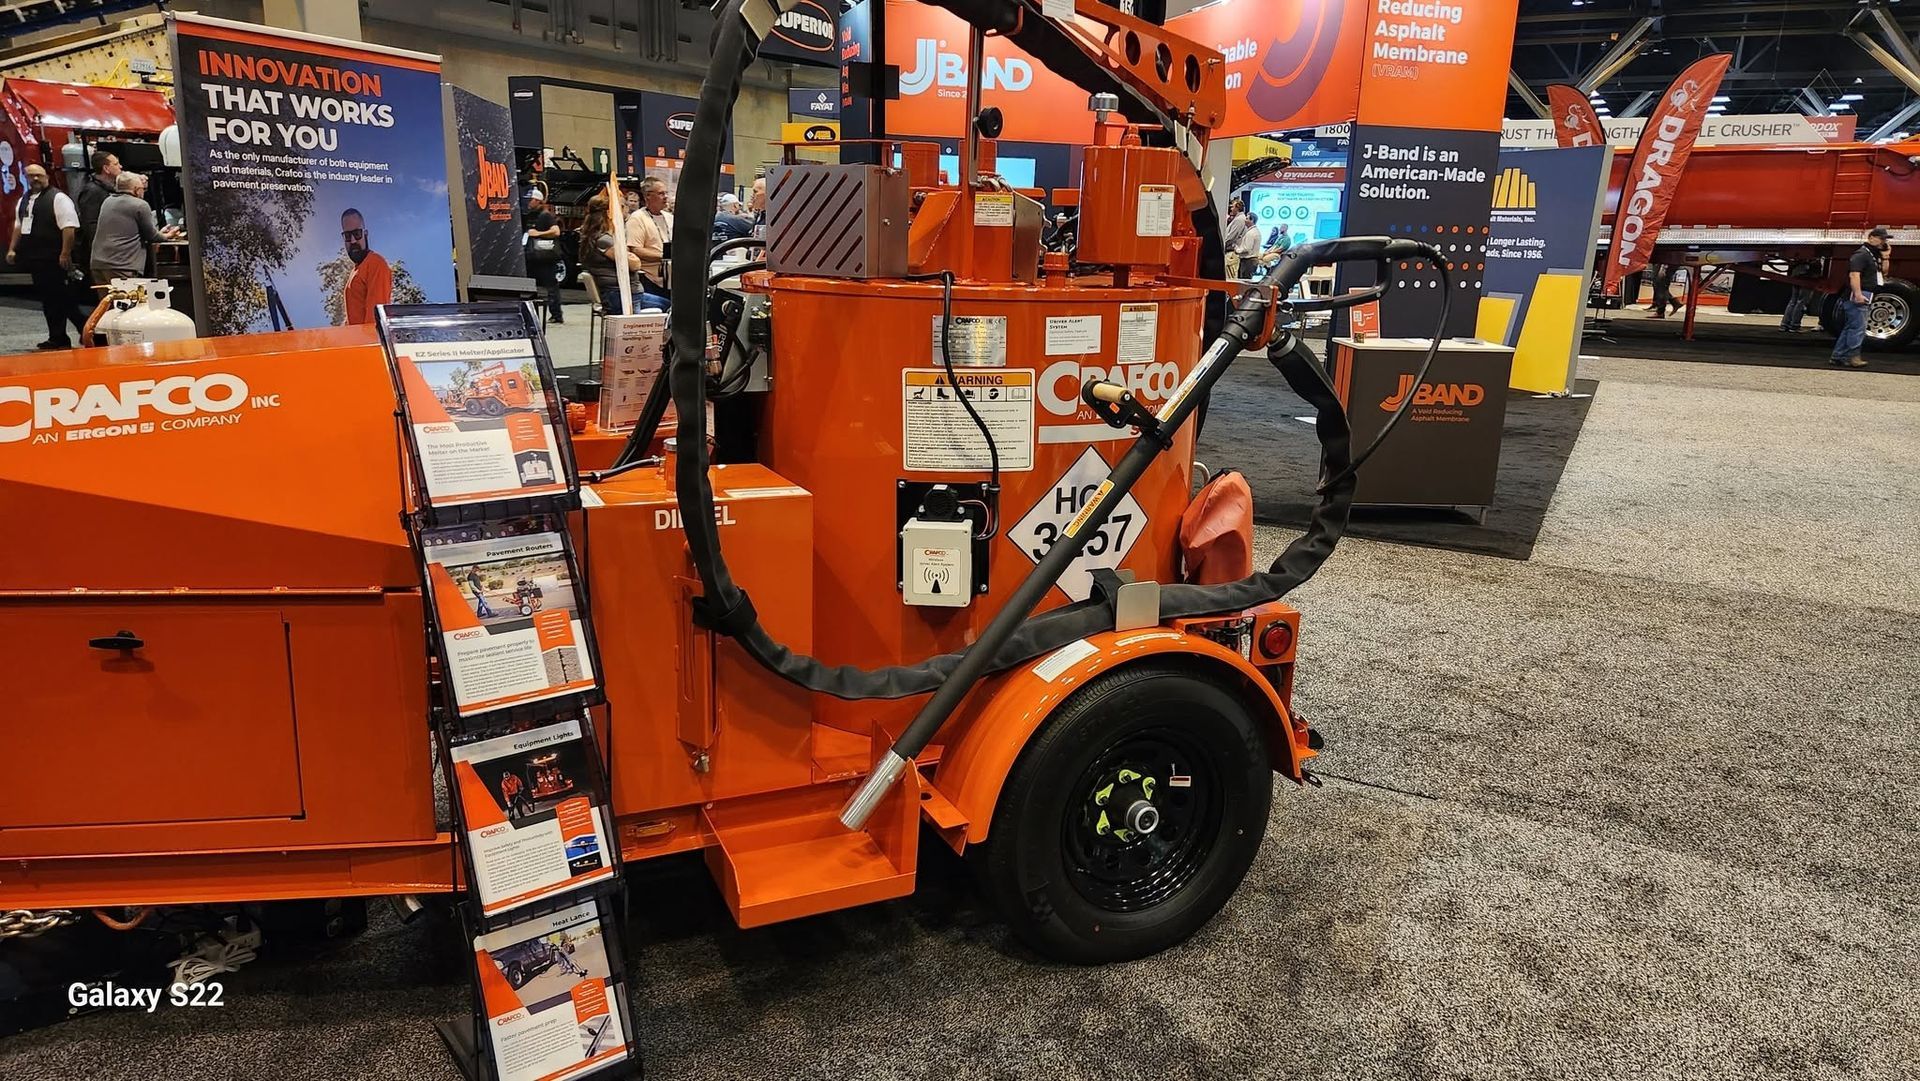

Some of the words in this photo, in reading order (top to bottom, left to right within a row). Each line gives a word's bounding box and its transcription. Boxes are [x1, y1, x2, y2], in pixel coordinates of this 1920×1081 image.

[1377, 0, 1463, 24] Reducing
[1375, 20, 1446, 42] Asphalt
[1218, 38, 1257, 65] nable
[1373, 42, 1469, 65] Membrane
[199, 50, 382, 97] INNOVATION
[1371, 63, 1420, 80] (VRAM)
[937, 89, 960, 98] Since
[201, 83, 284, 115] THAT
[288, 93, 394, 128] WORKS
[810, 102, 834, 111] FAYAT
[206, 116, 273, 146] FOR
[276, 123, 338, 151] YOU
[210, 149, 224, 159] As
[224, 150, 240, 160] the
[242, 152, 261, 163] only
[262, 154, 317, 166] manufacturer
[319, 157, 328, 167] of
[329, 158, 347, 168] both
[348, 160, 389, 172] equipment
[1362, 144, 1420, 162] J-Band
[1423, 146, 1436, 162] is
[1439, 149, 1459, 163] an
[211, 163, 230, 174] and
[231, 166, 274, 178] materials,
[275, 168, 303, 179] Crafco
[304, 170, 312, 179] is
[313, 170, 327, 180] the
[328, 171, 360, 184] industry
[360, 173, 384, 184] leader
[385, 175, 393, 184] in
[1283, 171, 1335, 179] DYNAPAC
[1361, 164, 1486, 183] American-Made
[213, 179, 259, 190] pavement
[260, 181, 314, 193] preservation.
[1359, 183, 1430, 200] Solution.
[1618, 114, 1686, 267] DRAGON
[1490, 237, 1515, 248] Longer
[1516, 237, 1546, 249] Lasting,
[1501, 249, 1522, 258] Since
[1523, 250, 1544, 259] 1956.
[459, 347, 524, 356] Melter/Applicator
[251, 394, 281, 409] INC
[1077, 409, 1093, 420] AN
[1433, 408, 1463, 416] Reducing
[32, 431, 59, 445] AN
[66, 424, 138, 442] ERGON
[160, 412, 243, 431] COMPANY
[655, 505, 736, 530] DIEL
[1073, 496, 1101, 527] WARNING
[1033, 514, 1132, 560] 357
[486, 547, 524, 558] Pavement
[525, 543, 554, 553] Routers
[513, 737, 552, 750] Equipment
[553, 731, 574, 742] Lights
[552, 917, 569, 927] Heat
[570, 911, 590, 922] Lance
